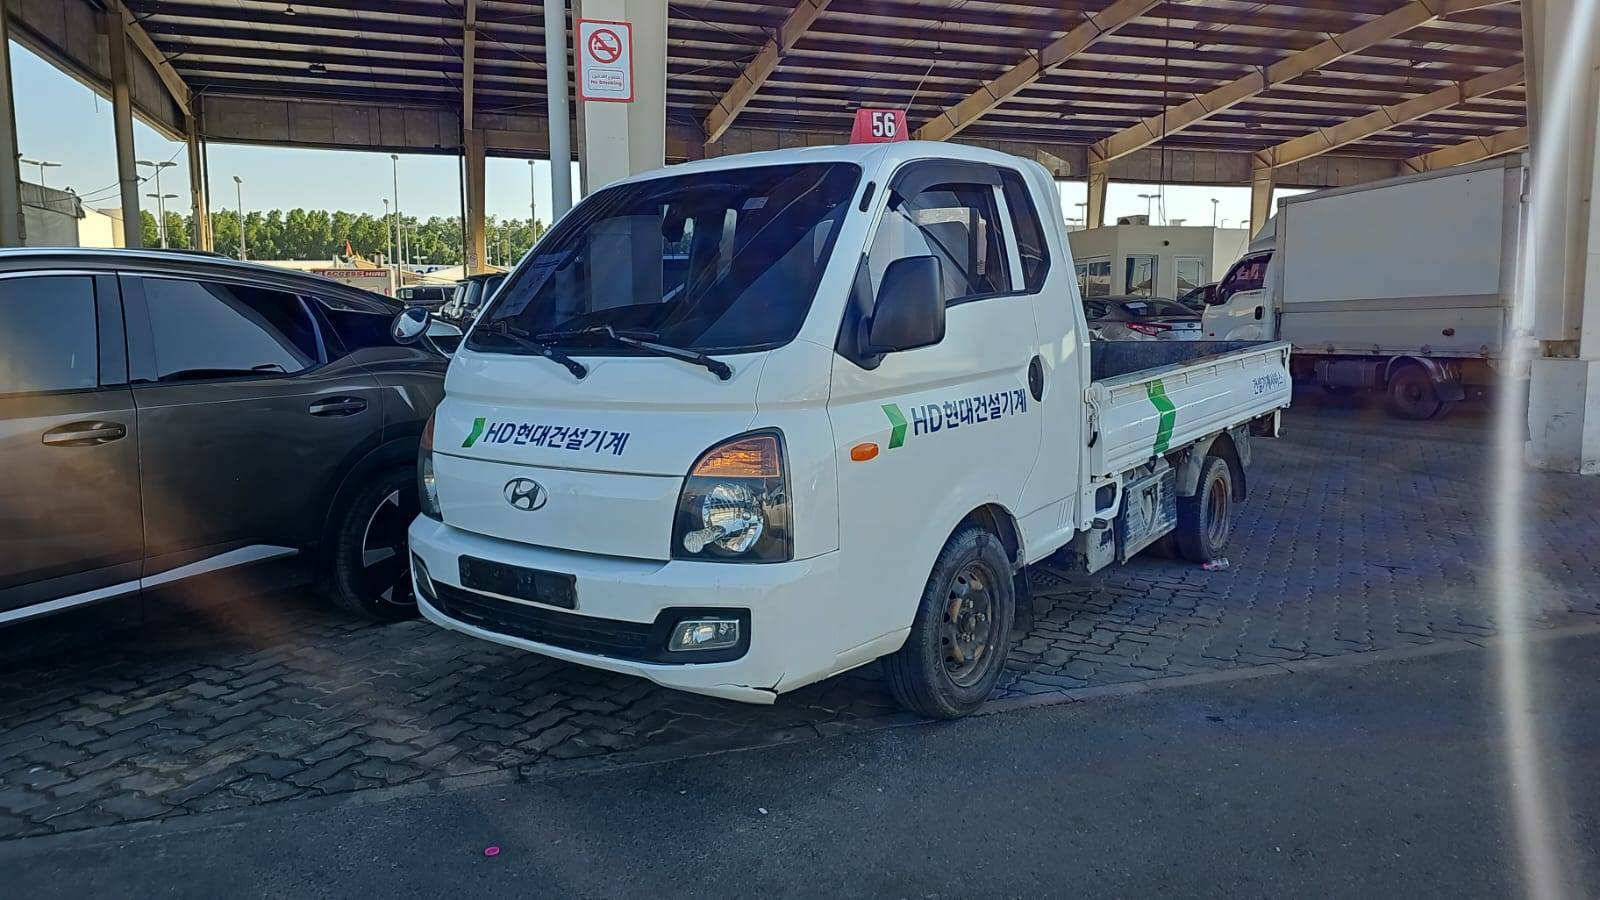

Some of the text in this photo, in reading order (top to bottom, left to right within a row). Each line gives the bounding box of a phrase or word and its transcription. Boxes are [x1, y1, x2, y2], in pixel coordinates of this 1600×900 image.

[872, 111, 896, 138] 56
[911, 388, 1027, 436] HD현대건설기계
[483, 422, 630, 456] HD현대건설기계
